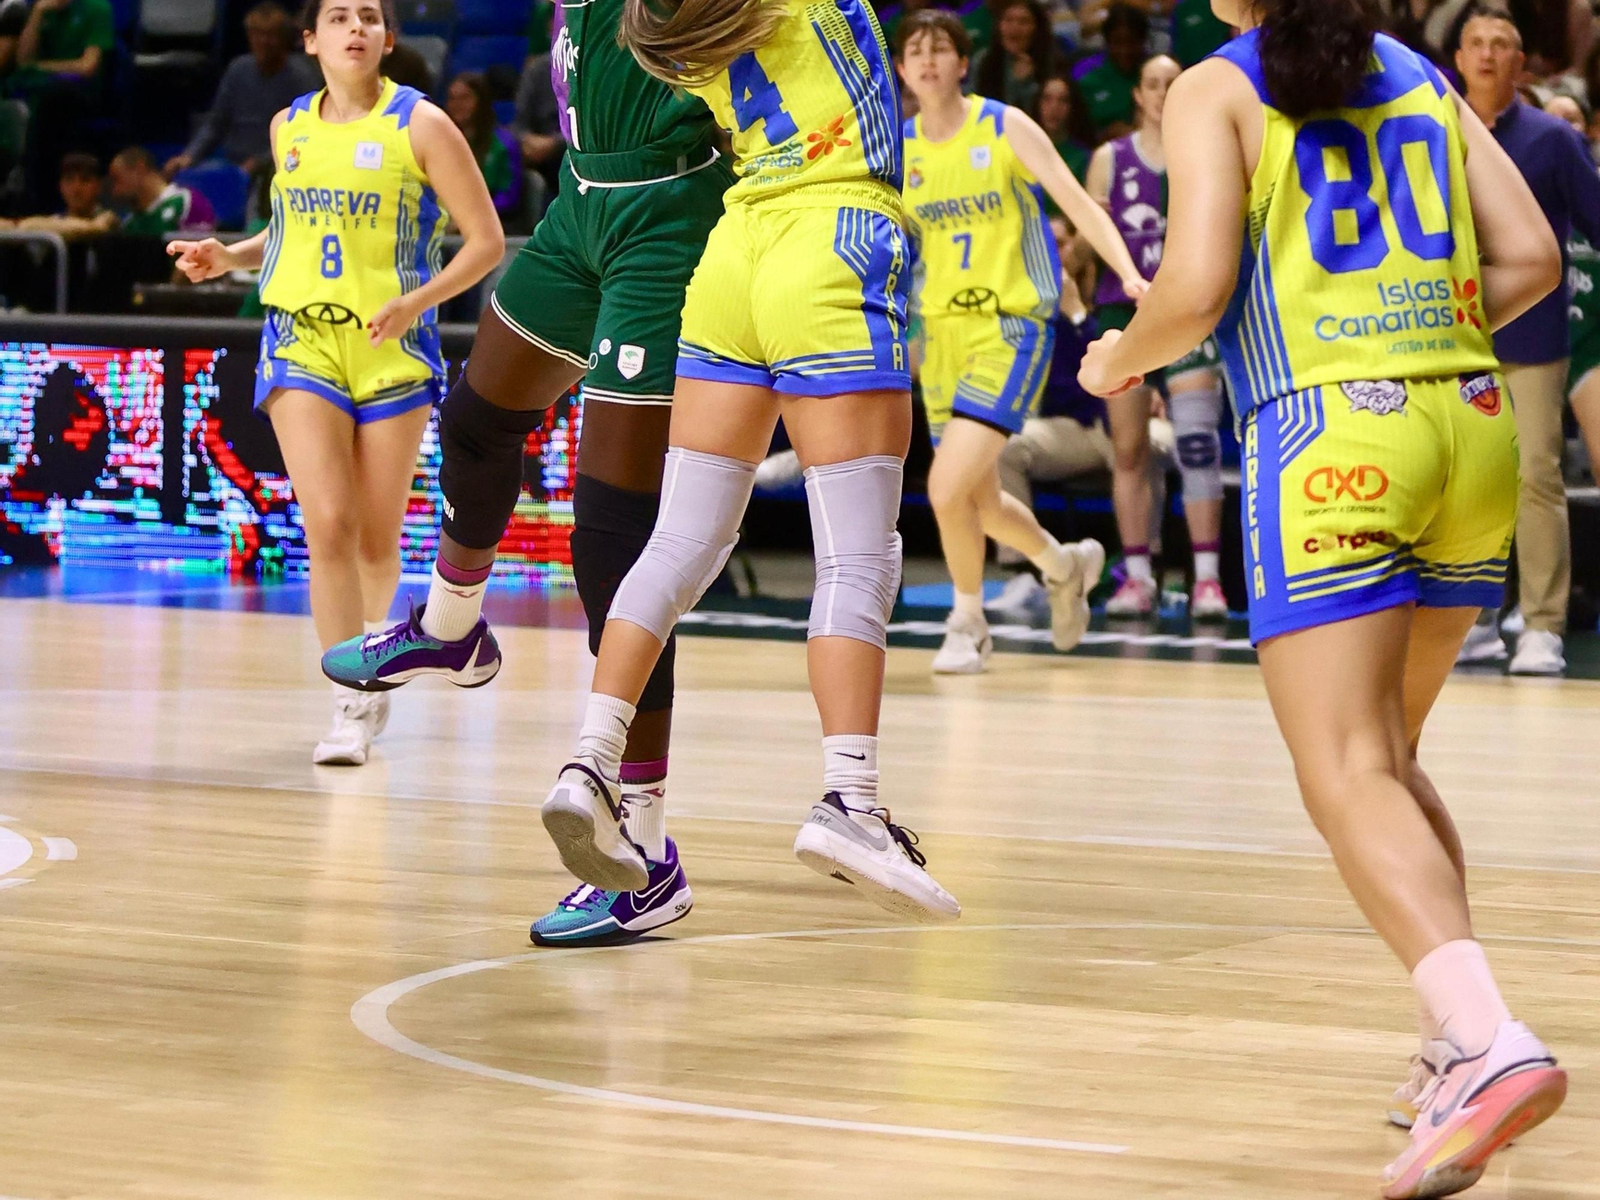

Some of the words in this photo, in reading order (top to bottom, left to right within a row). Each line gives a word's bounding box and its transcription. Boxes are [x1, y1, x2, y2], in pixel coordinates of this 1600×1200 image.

[728, 51, 799, 147] 4
[1294, 114, 1457, 275] 80
[321, 234, 343, 280] 8
[952, 232, 973, 270] 7
[1377, 277, 1450, 307] Islas
[1314, 303, 1454, 341] Canarias
